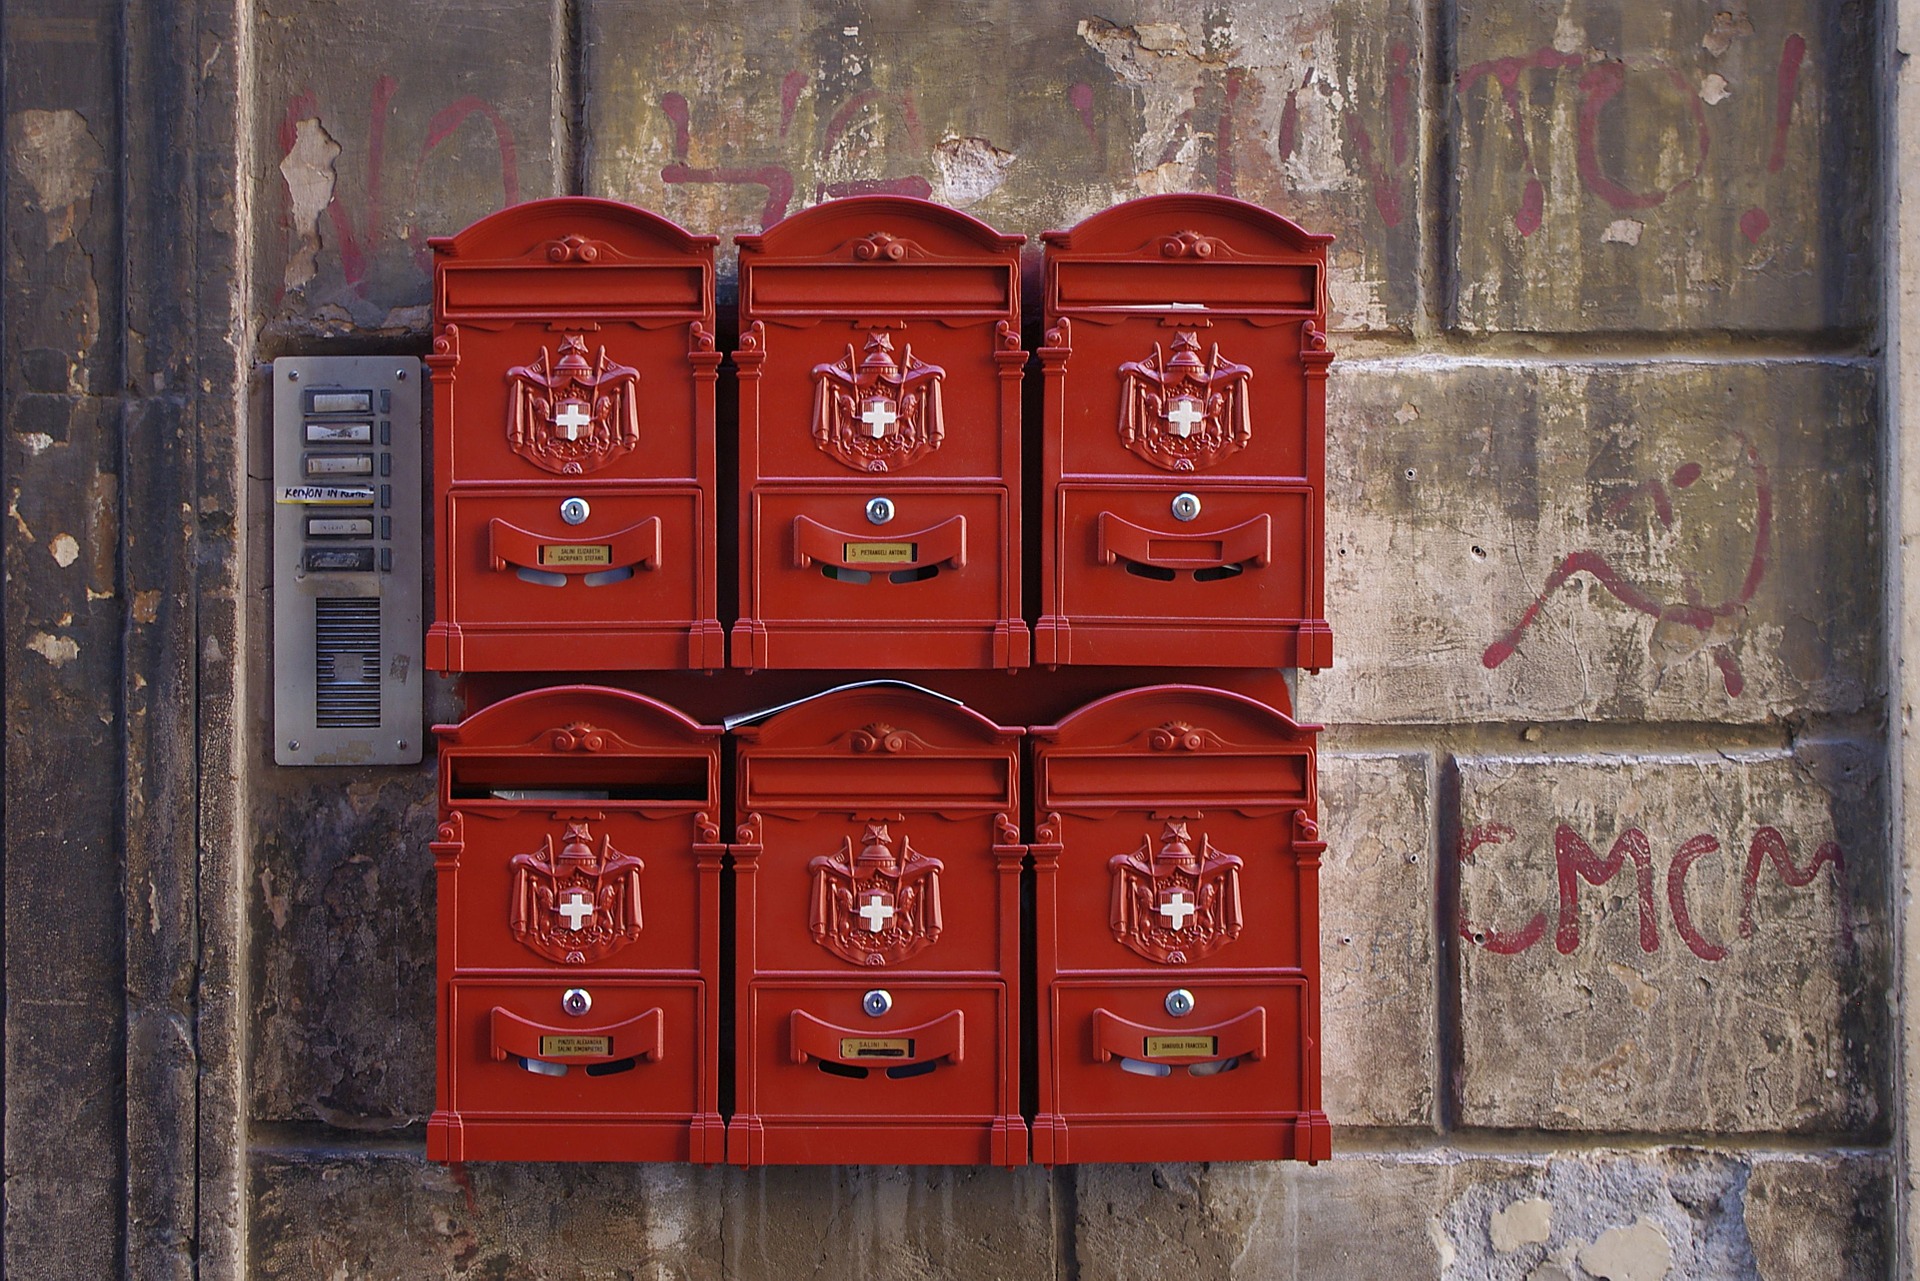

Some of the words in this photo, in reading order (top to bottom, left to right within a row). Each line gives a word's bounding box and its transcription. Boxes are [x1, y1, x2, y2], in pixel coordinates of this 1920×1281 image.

[327, 488, 339, 498] IN
[851, 548, 857, 557] 5
[1152, 1041, 1158, 1051] 3
